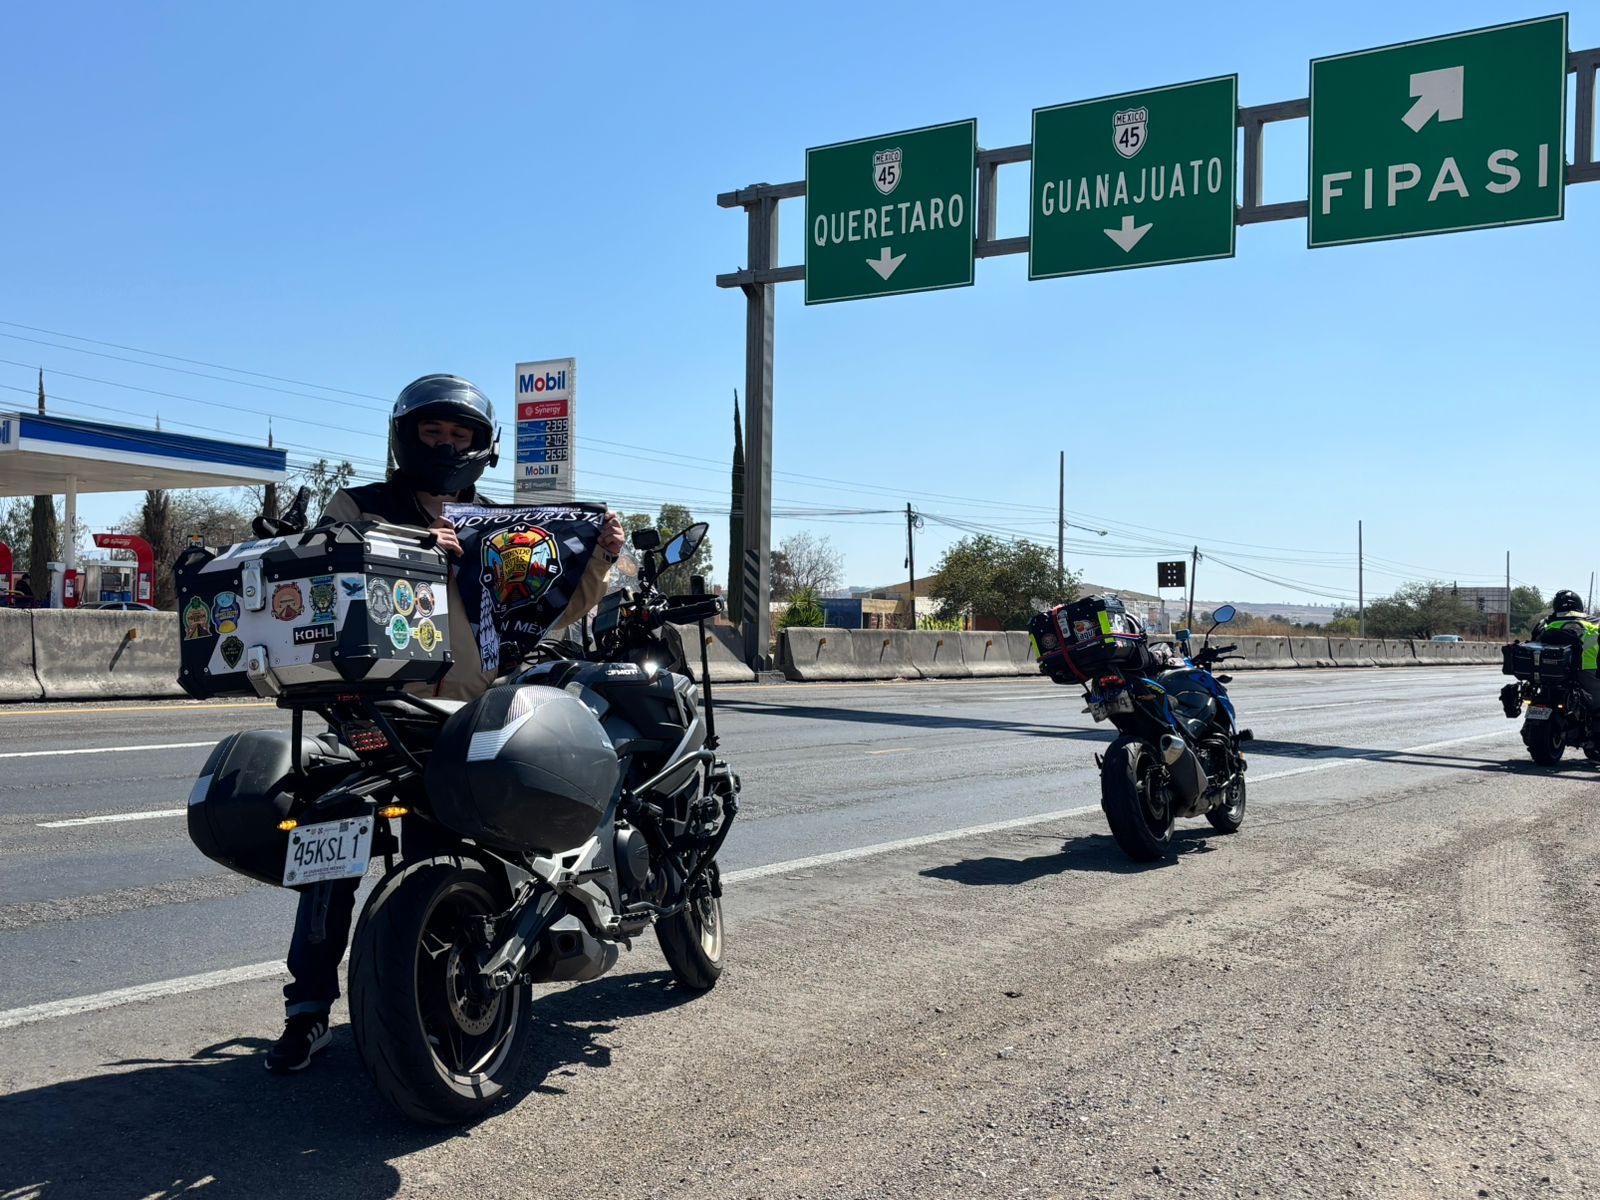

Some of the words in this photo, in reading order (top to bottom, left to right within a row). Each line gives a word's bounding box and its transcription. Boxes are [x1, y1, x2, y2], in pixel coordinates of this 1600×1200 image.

[1116, 111, 1144, 124] MEXICO
[1119, 126, 1139, 148] 45
[876, 152, 899, 162] MEXICO
[878, 165, 896, 185] 45
[1322, 144, 1548, 215] FIPASI
[1041, 157, 1222, 216] GUANAJUATO
[814, 194, 964, 247] QUERETARO
[520, 371, 566, 393] Mobil
[534, 405, 561, 417] Synergy
[525, 465, 550, 476] Mobil
[295, 627, 334, 642] KOHL
